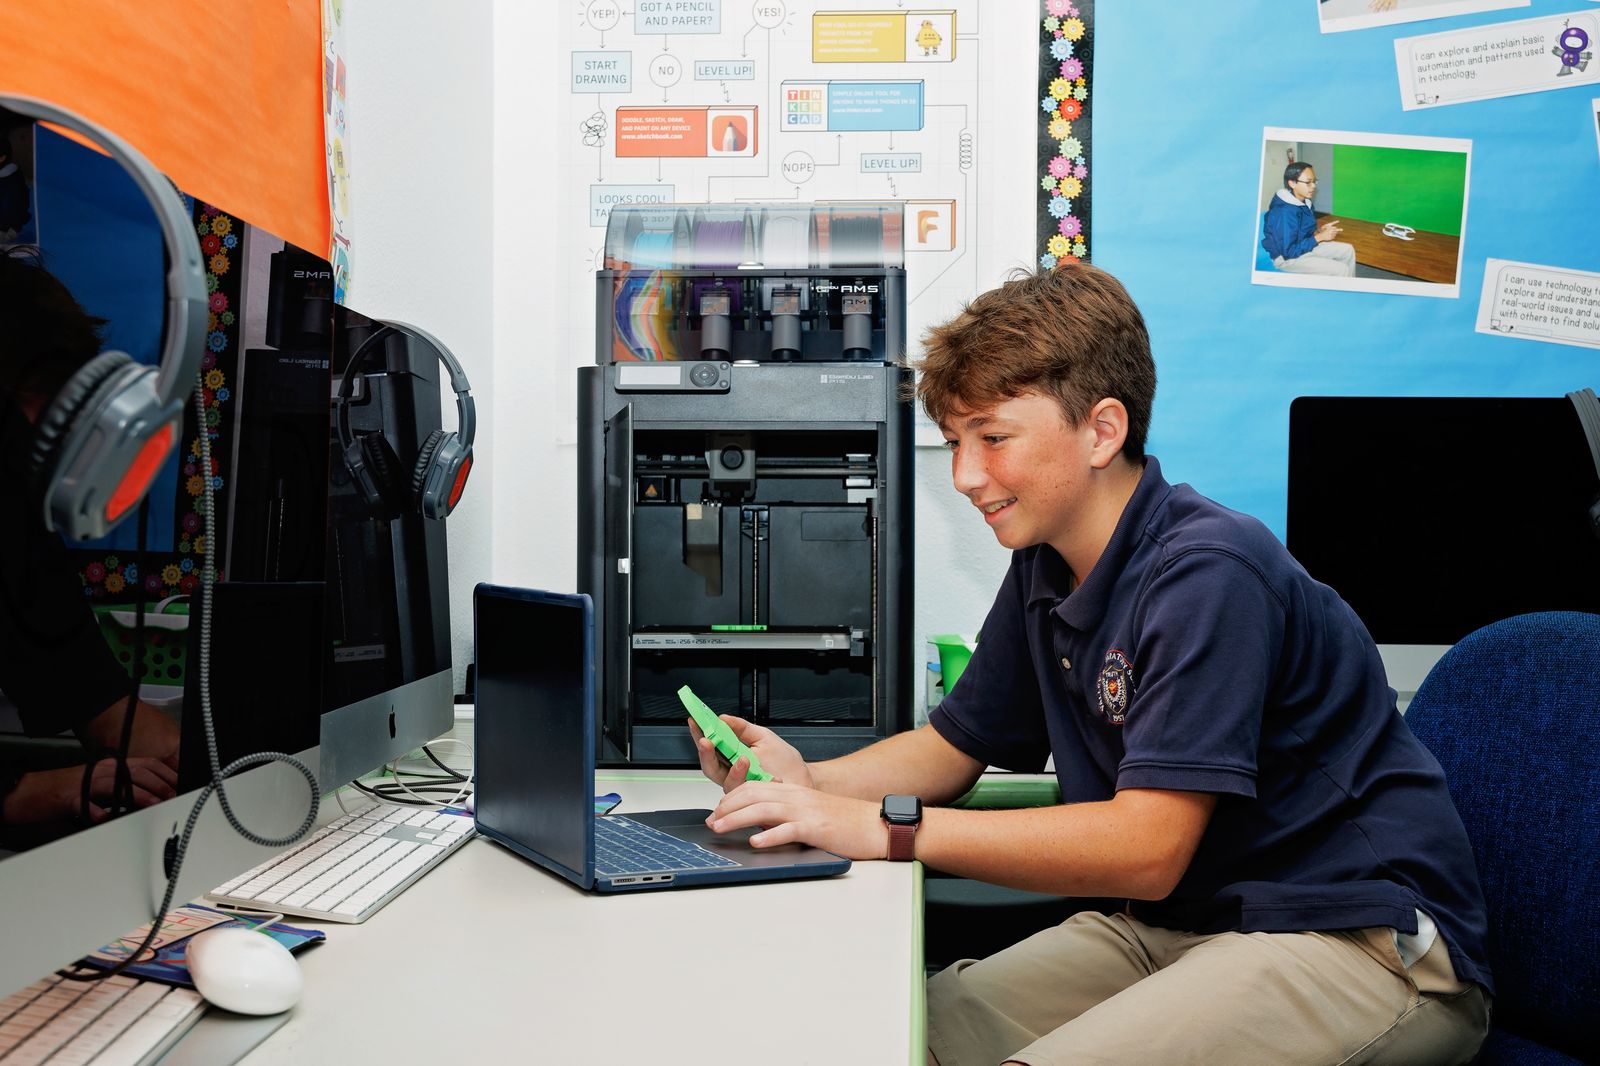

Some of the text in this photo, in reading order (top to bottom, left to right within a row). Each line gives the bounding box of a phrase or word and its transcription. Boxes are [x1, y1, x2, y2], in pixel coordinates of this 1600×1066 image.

[640, 2, 715, 12] GOT A PENCIL
[757, 7, 781, 17] YES!
[591, 9, 615, 19] YEP!
[645, 16, 713, 26] AND PAPER?
[1420, 52, 1436, 60] can
[1438, 45, 1470, 58] explore
[1473, 41, 1488, 52] and
[1490, 38, 1521, 51] explain
[1522, 35, 1545, 45] basic
[1417, 45, 1545, 73] automation and patterns used
[584, 60, 618, 71] START
[658, 66, 675, 76] NO
[698, 66, 752, 76] LEVEL UP!
[1429, 69, 1477, 82] technology.
[575, 74, 627, 84] DRAWING
[783, 162, 813, 172] NOPE
[864, 159, 919, 169] LEVEL UP!
[599, 194, 666, 204] LOOKS COOL!
[840, 285, 879, 293] AMS
[1510, 276, 1525, 285] can
[1528, 279, 1542, 287] use
[1545, 279, 1592, 296] technology
[1504, 286, 1535, 297] explore
[1537, 291, 1553, 300] and
[1502, 298, 1546, 311] real-world
[1547, 303, 1574, 315] issues
[1575, 308, 1592, 317] and
[1499, 309, 1518, 319] with
[1520, 311, 1548, 323] others
[1550, 316, 1559, 325] to
[1563, 316, 1581, 328] find
